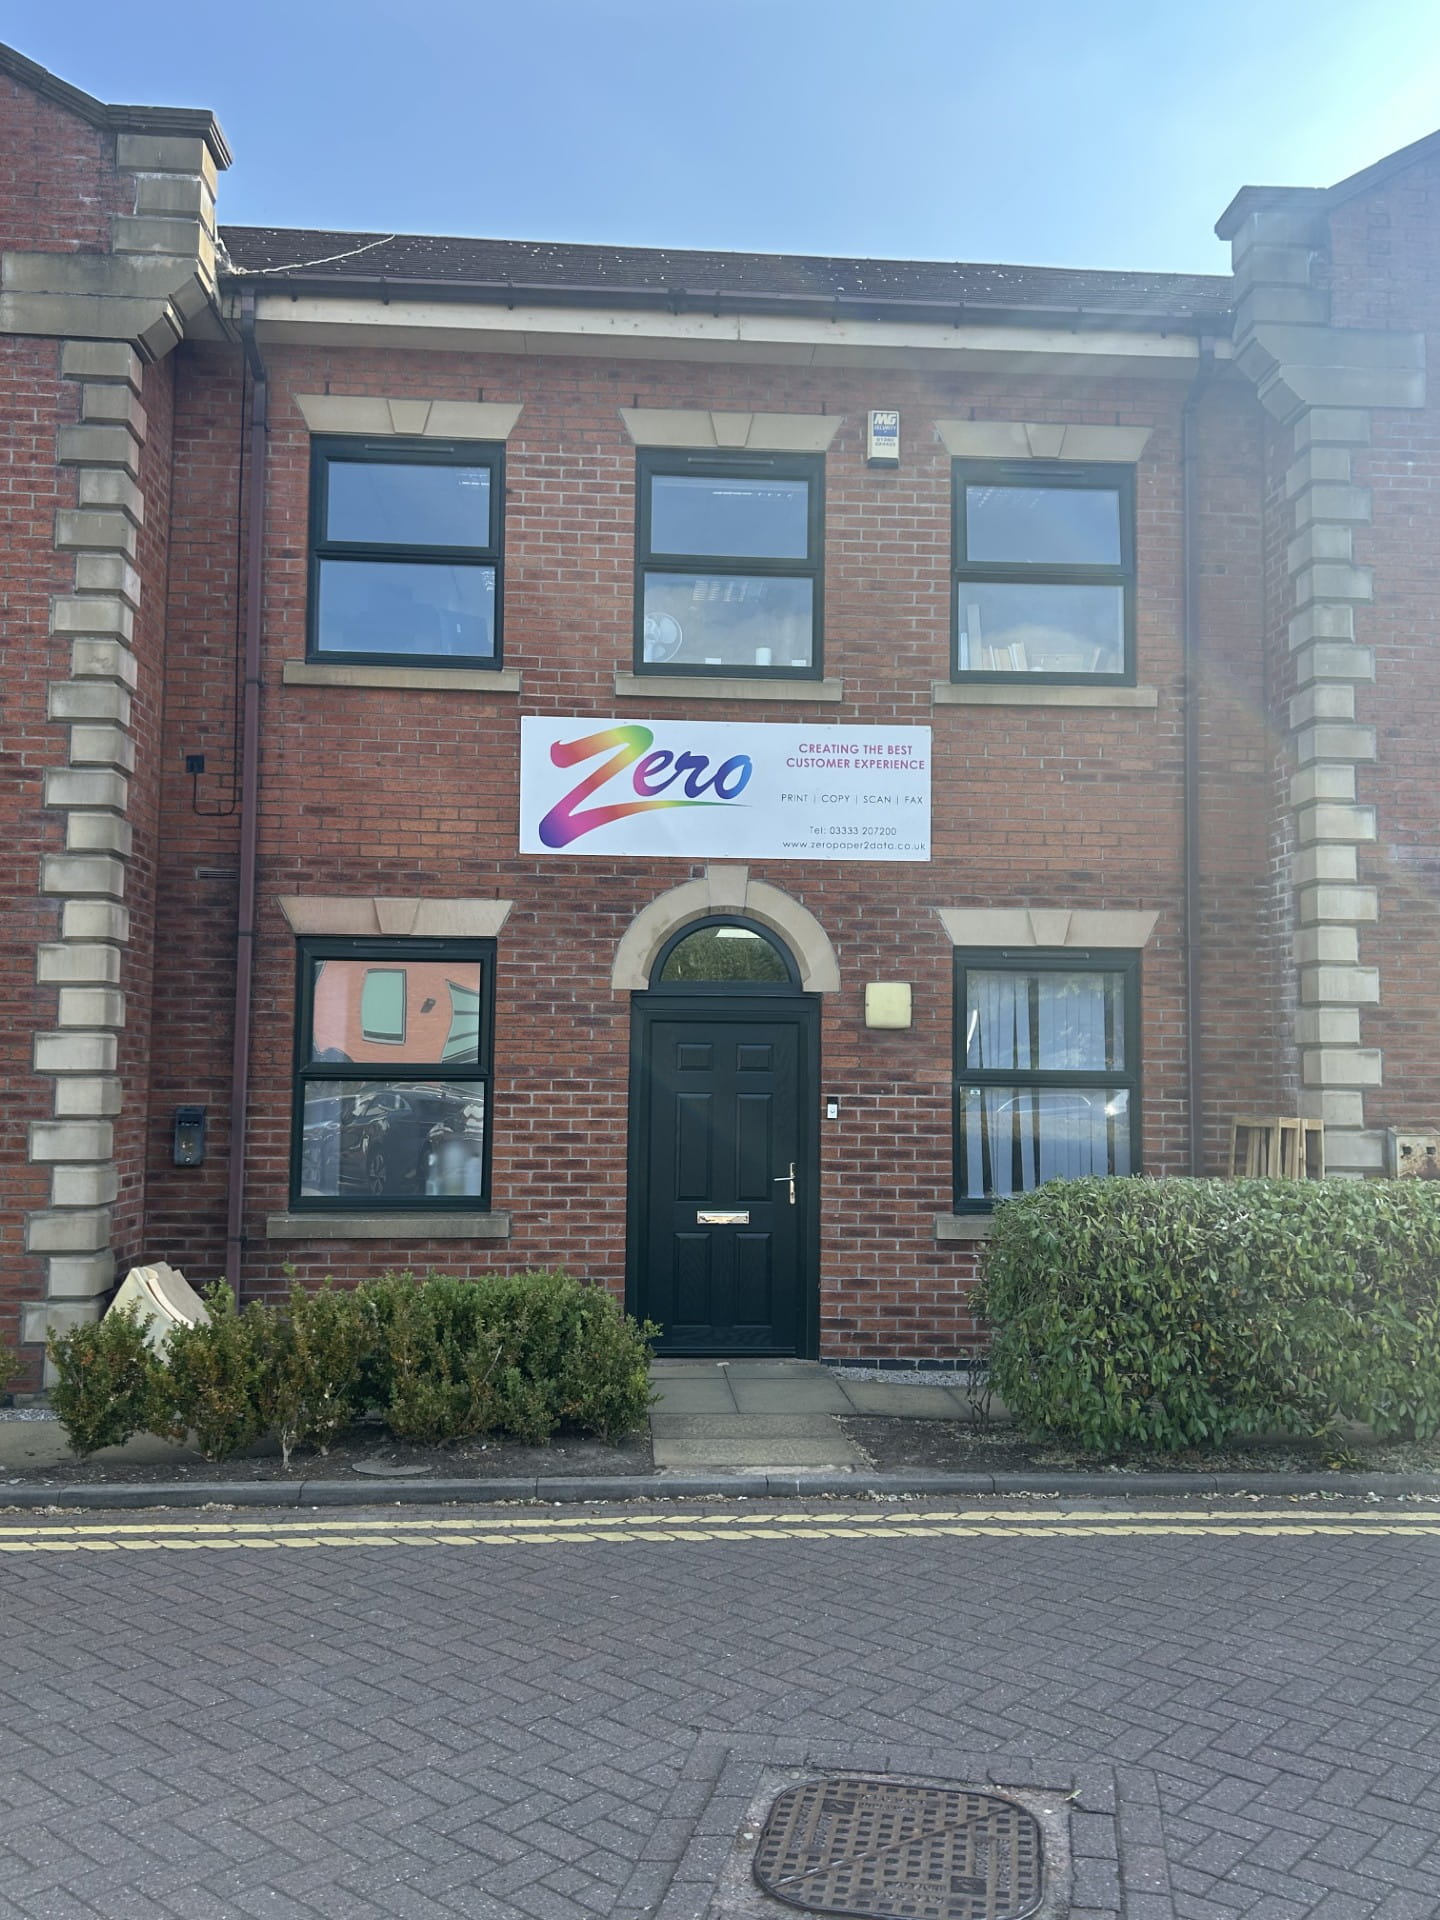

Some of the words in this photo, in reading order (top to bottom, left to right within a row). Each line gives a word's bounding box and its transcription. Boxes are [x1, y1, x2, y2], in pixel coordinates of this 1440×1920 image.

[798, 743, 860, 755] CREATING
[863, 744, 884, 755] THE
[887, 745, 913, 755] BEST
[786, 757, 850, 769] CUSTOMER
[854, 759, 925, 770] EXPERIENCE
[539, 724, 753, 849] Zero
[781, 793, 809, 803] PRINT
[821, 794, 850, 804] COPY
[863, 795, 892, 804] SCAN
[904, 796, 923, 805] FAX
[809, 825, 826, 835] Tel:
[829, 826, 859, 835] 03333
[862, 826, 897, 836] 207200
[782, 840, 926, 850] www.zeropaper2data.co.uk
